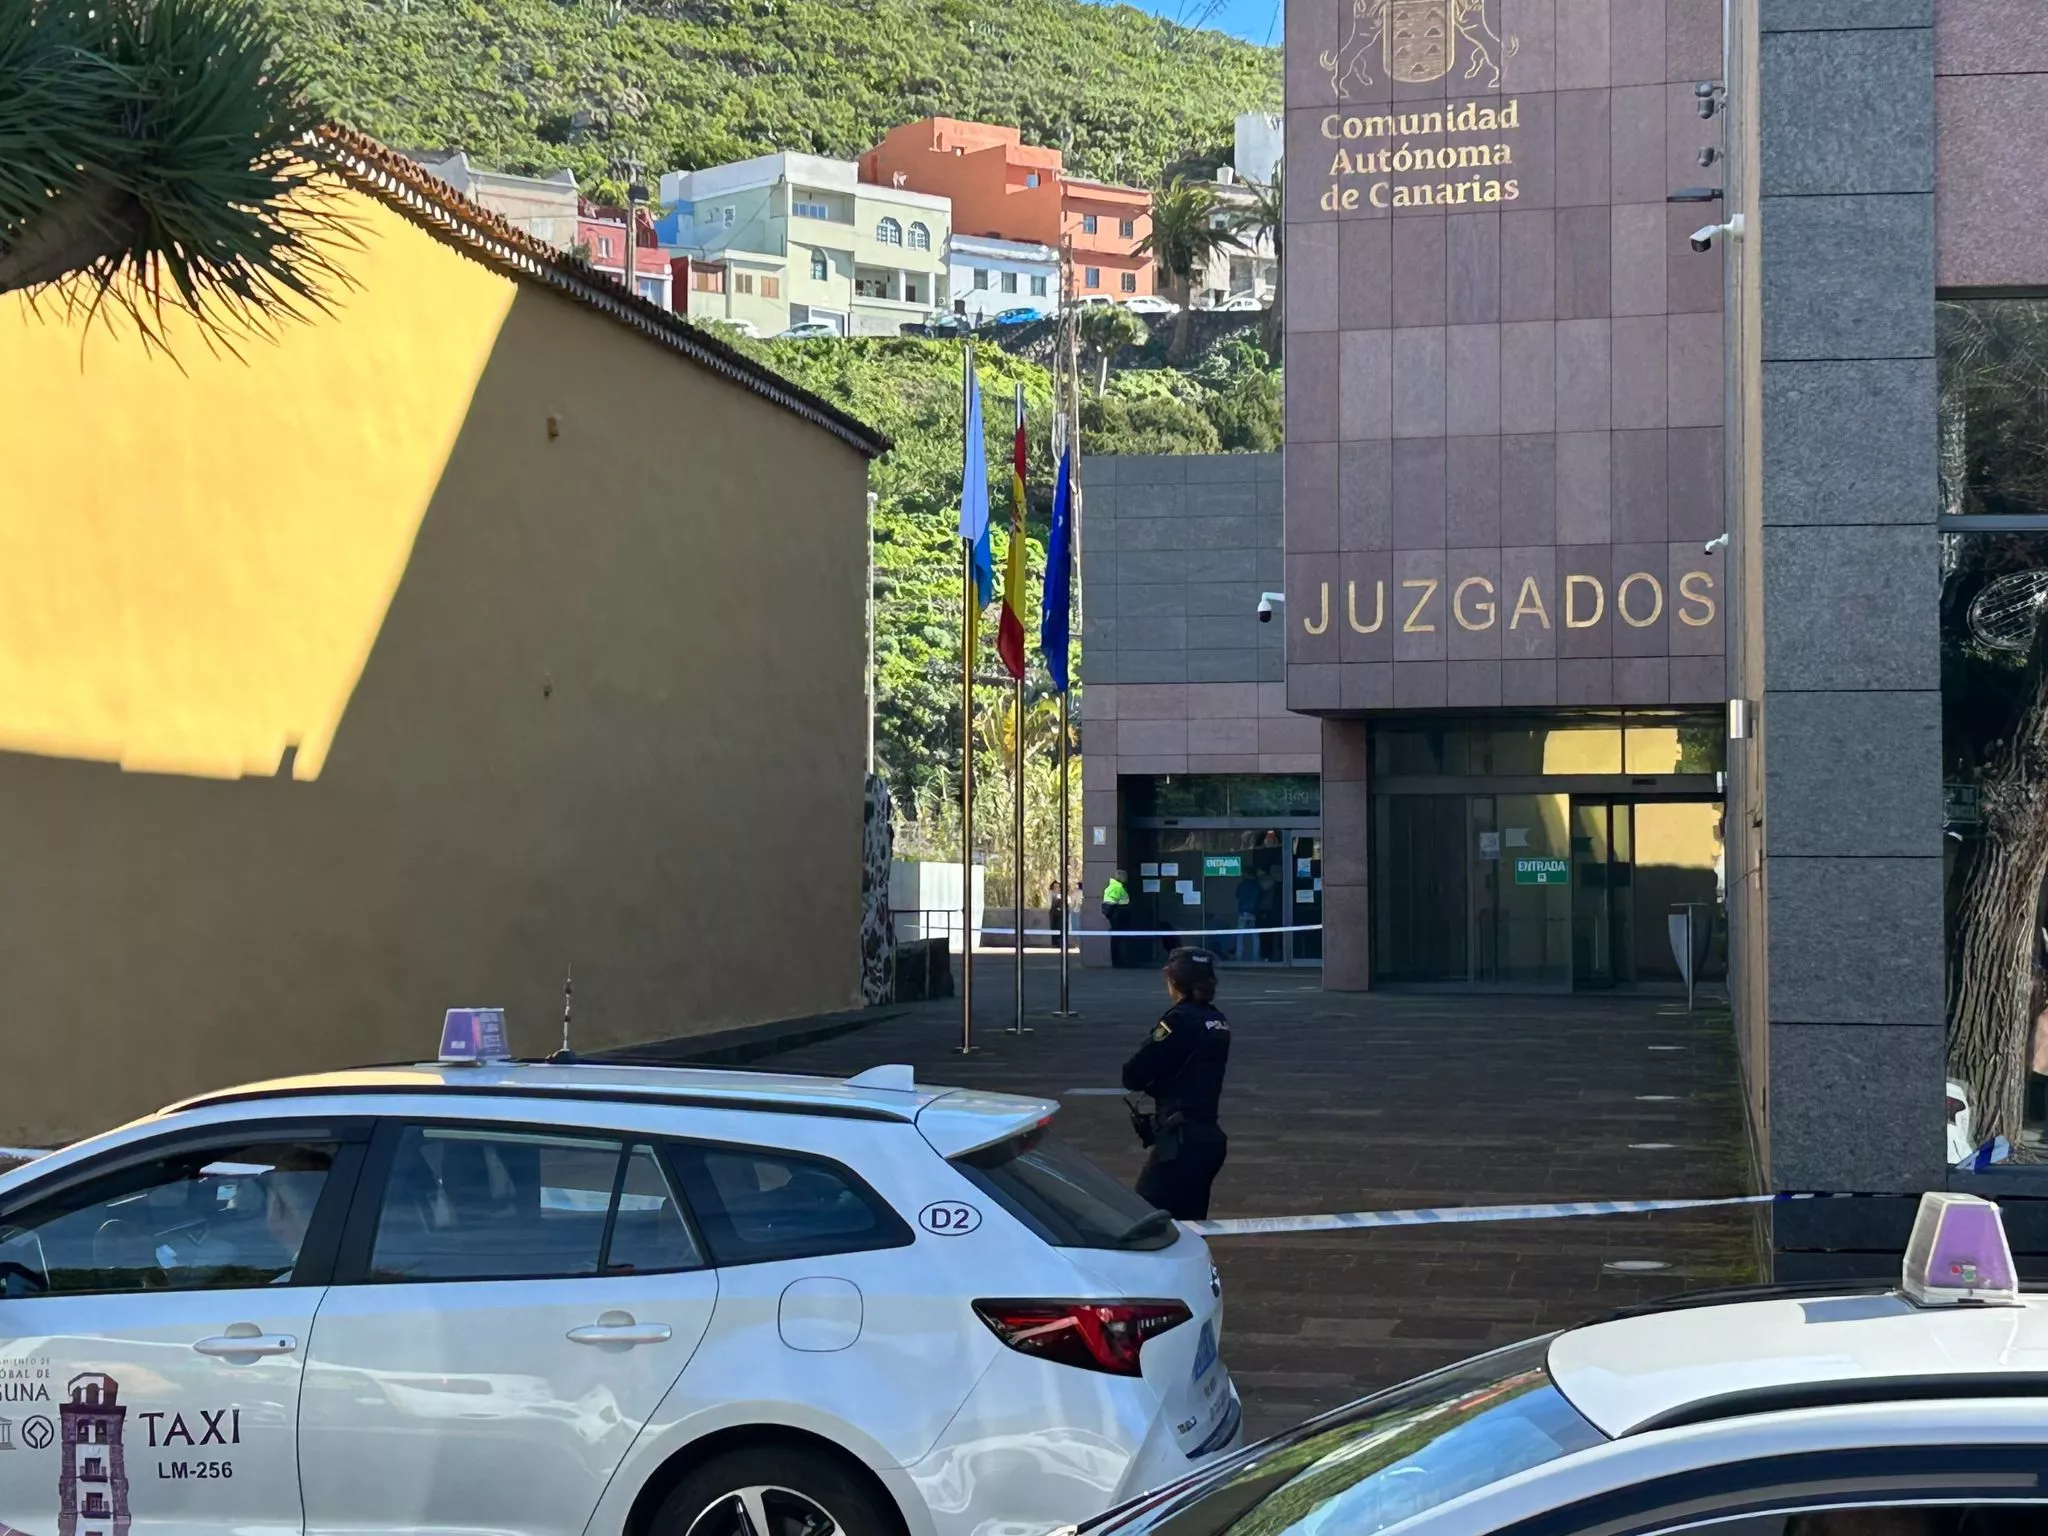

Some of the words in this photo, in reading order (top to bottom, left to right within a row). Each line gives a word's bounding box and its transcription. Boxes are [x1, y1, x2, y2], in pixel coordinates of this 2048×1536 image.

[1321, 99, 1520, 139] Comunidad
[1328, 142, 1512, 176] Autónoma
[1320, 184, 1360, 211] de
[1369, 174, 1520, 208] Canarias
[1303, 571, 1717, 635] JUZGADOS
[1517, 860, 1566, 872] ENTRADA
[931, 1208, 970, 1229] D2
[0, 1382, 51, 1402] UNA
[139, 1408, 241, 1447] TAXI
[158, 1461, 234, 1480] LM-256
